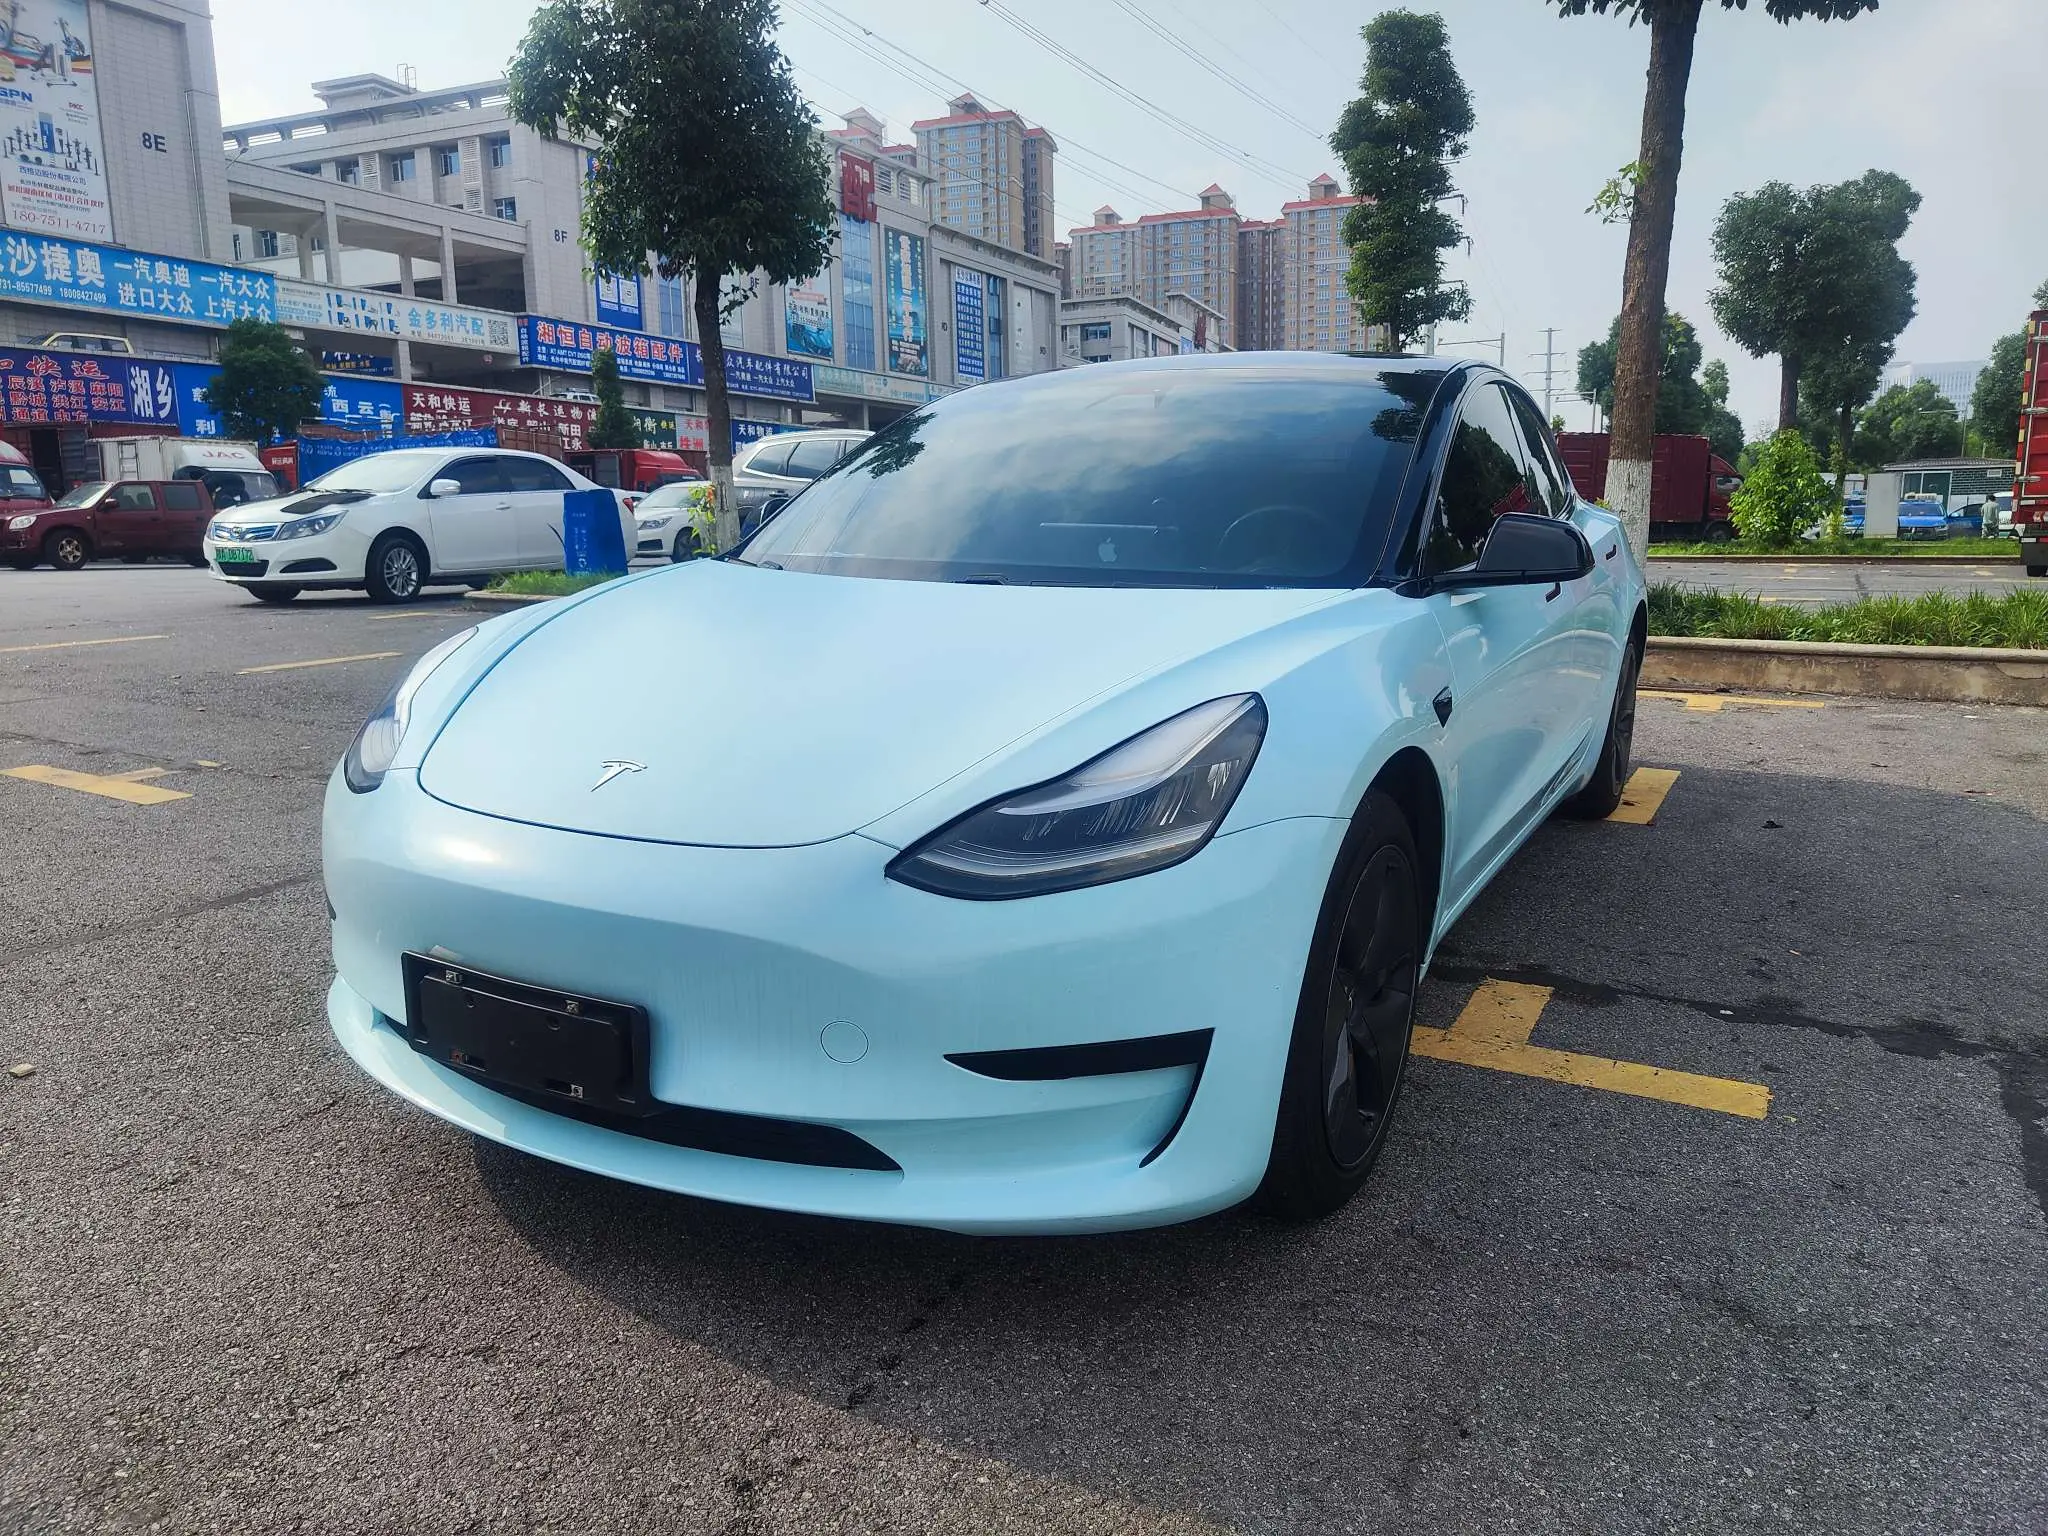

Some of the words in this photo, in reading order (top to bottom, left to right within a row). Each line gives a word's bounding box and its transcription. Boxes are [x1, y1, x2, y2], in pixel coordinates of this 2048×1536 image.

[142, 132, 167, 153] 8E
[12, 209, 106, 235] 180-7511-4717
[554, 229, 568, 244] 8F
[0, 236, 105, 289] 沙捷奥
[114, 257, 191, 289] 一汽奥迪
[201, 271, 271, 301] 一汽大众
[118, 282, 195, 315] 进口大众
[204, 298, 273, 324] 上汽大众
[408, 307, 485, 337] 金多利汽配
[537, 320, 684, 364] 湘恒自动波箱配件
[130, 365, 173, 420] 湘乡
[412, 392, 472, 415] 天和快运
[203, 450, 246, 459] JAC
